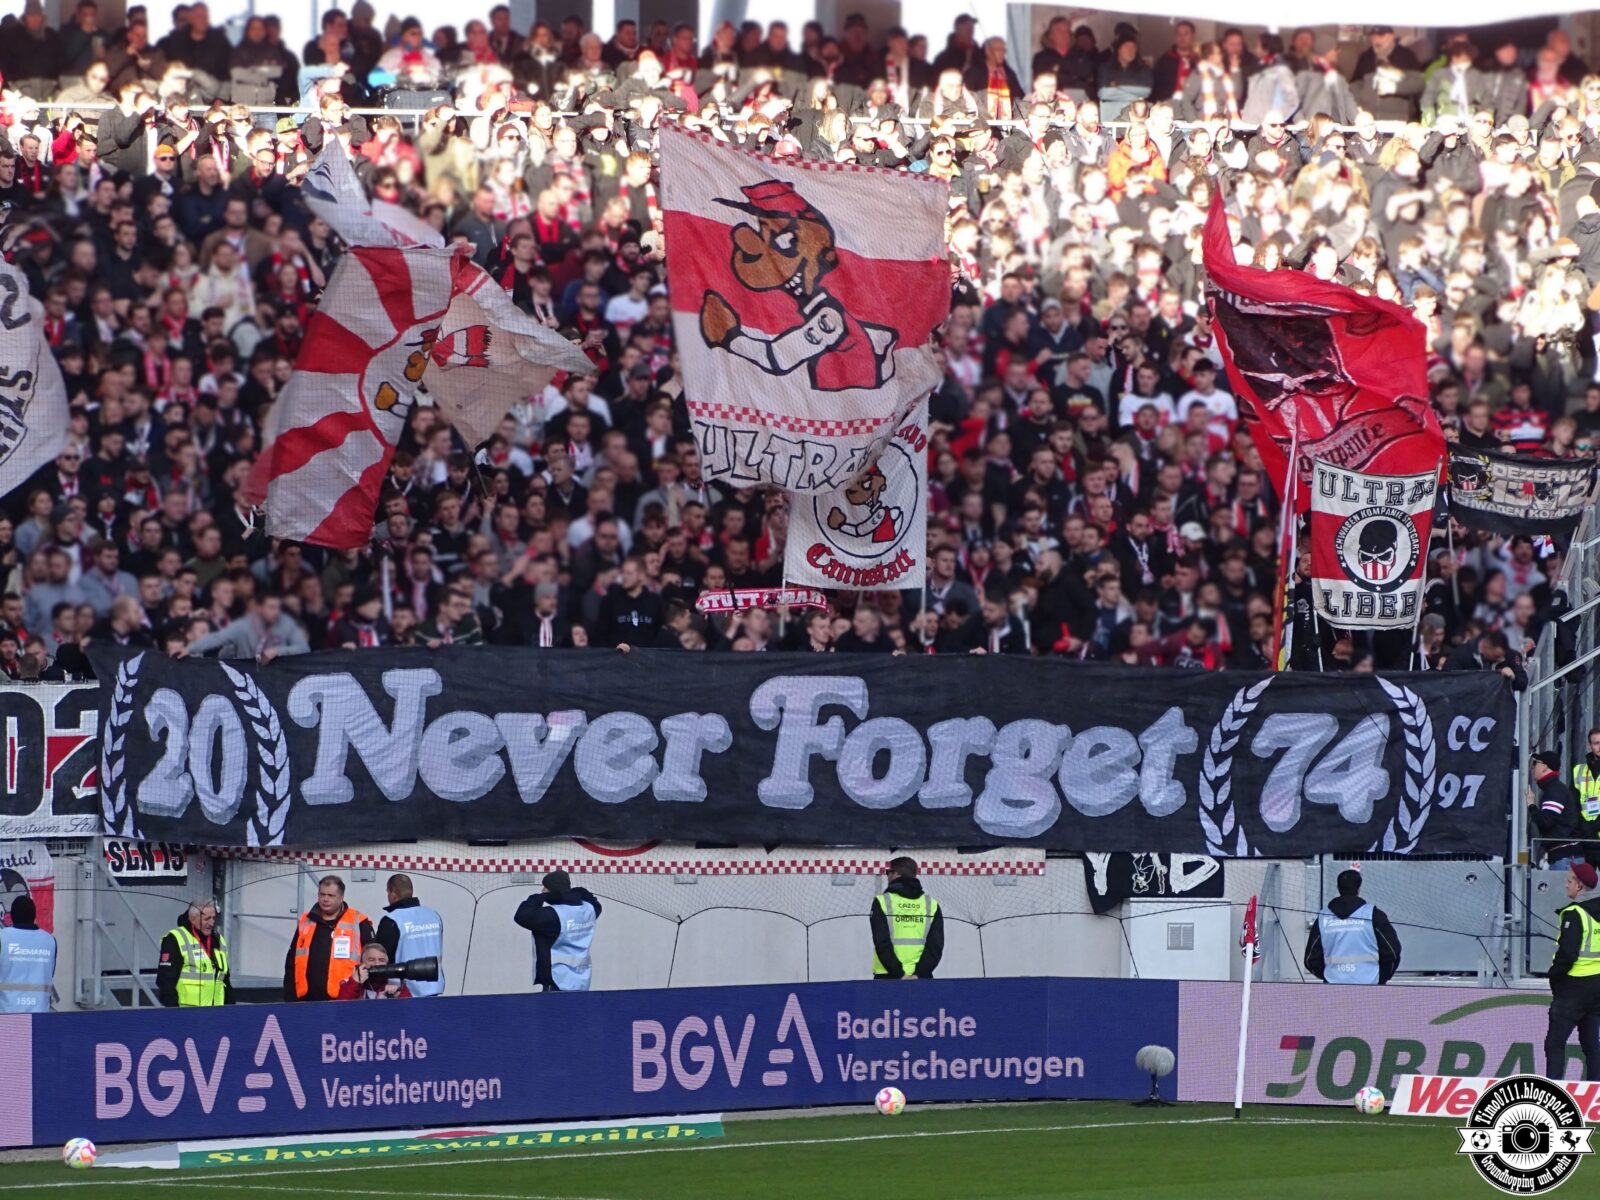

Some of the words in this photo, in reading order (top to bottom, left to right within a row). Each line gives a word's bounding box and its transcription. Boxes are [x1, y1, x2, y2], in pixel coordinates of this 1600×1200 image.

[1447, 715, 1497, 752] CC
[136, 687, 248, 824] 20
[287, 668, 733, 805] Never
[749, 675, 1198, 838] Forget
[1249, 711, 1390, 832] 74
[1438, 772, 1486, 808] 97
[837, 1008, 977, 1040] Badische
[321, 1029, 428, 1064] Badische
[632, 1013, 756, 1093] BGV
[95, 1036, 230, 1119] BGV
[837, 1050, 1085, 1085] Versicherungen
[321, 1074, 502, 1110] Versicherungen
